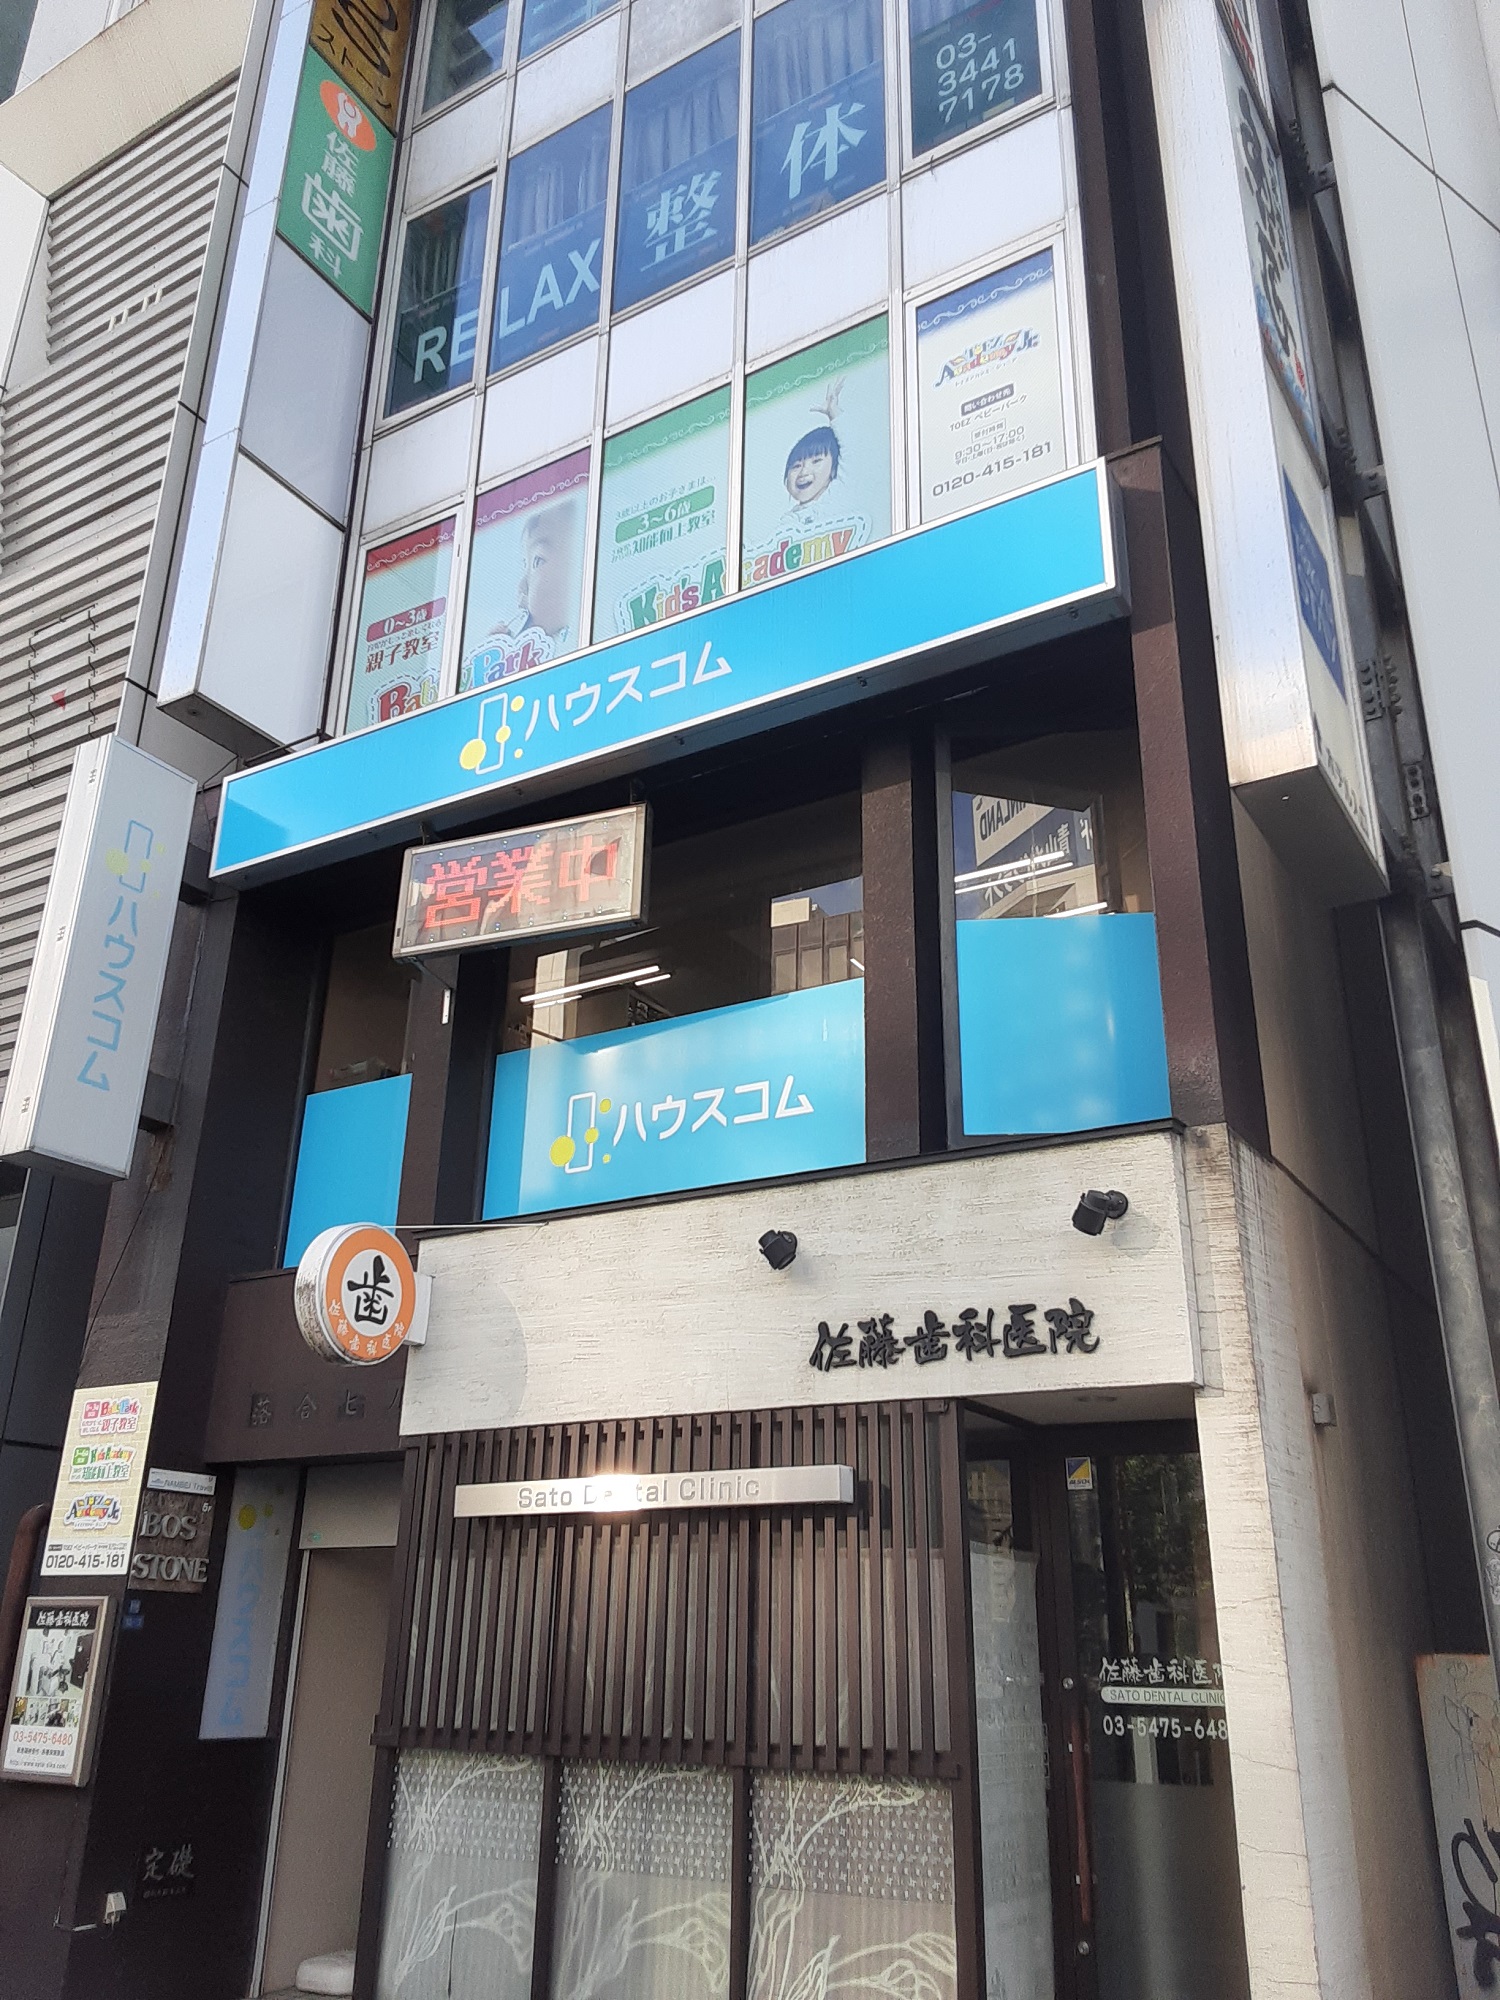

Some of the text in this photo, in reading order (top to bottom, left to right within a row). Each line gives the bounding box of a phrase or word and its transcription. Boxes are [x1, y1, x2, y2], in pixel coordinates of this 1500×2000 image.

[316, 24, 392, 109] ストーン
[936, 32, 992, 69] 03-
[938, 37, 1016, 97] 3441
[939, 63, 1025, 124] 7178
[302, 131, 365, 279] 佐藤歯科
[413, 237, 601, 384] RELAX
[949, 417, 972, 432] TOEZ
[932, 440, 1052, 497] 0120-415-181
[365, 630, 440, 674] 親子教室
[473, 640, 544, 690] Park
[524, 640, 734, 742] ハウスコム
[424, 835, 619, 930] 営業中
[77, 895, 138, 1092] ハウスコム
[612, 1073, 815, 1147] ハウスコム
[346, 1254, 395, 1326] 歯
[328, 1298, 406, 1358] 佐藤歯科医院
[809, 1296, 1101, 1373] 佐藤歯科医院
[517, 1487, 573, 1509] Sato
[678, 1475, 761, 1502] Clinic
[139, 1511, 198, 1541] BOS
[45, 1553, 126, 1569] 0120-415-181
[131, 1552, 210, 1584] STONE
[36, 1609, 91, 1627] 佐藤歯科医院
[1110, 1688, 1140, 1702] SATO
[1144, 1689, 1188, 1704] DENTAL
[13, 1729, 74, 1746] 03-5475-6480
[142, 1843, 195, 1881] 定礎
